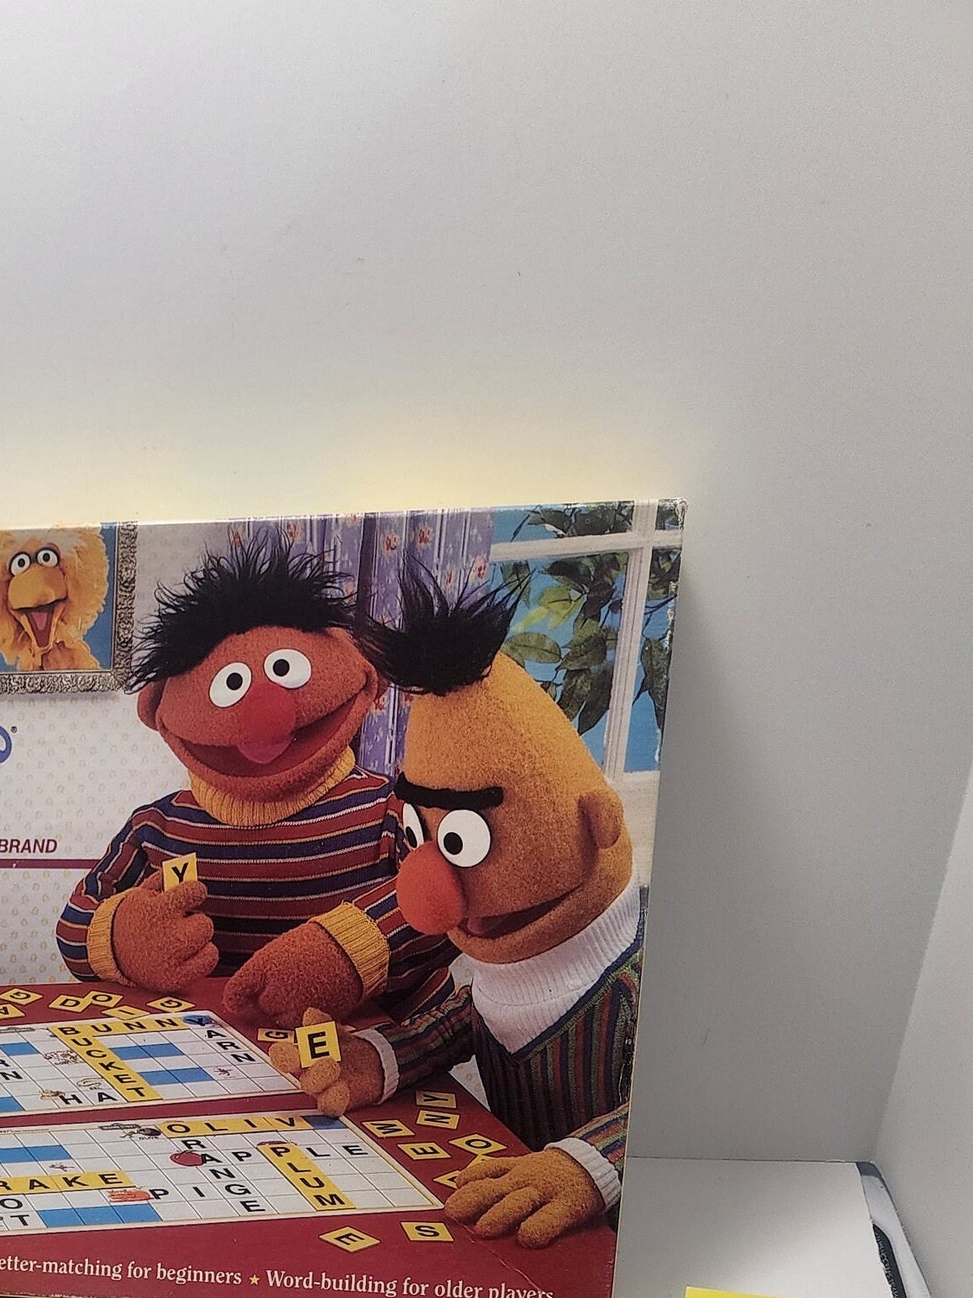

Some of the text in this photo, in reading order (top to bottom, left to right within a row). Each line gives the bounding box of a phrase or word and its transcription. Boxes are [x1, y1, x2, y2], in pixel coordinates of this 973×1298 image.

[171, 862, 189, 883] Y
[308, 1031, 330, 1059] E
[415, 1225, 440, 1237] S
[127, 1261, 153, 1279] for
[156, 1264, 242, 1286] beginners
[266, 1269, 397, 1298] Word-building
[402, 1276, 428, 1296] for
